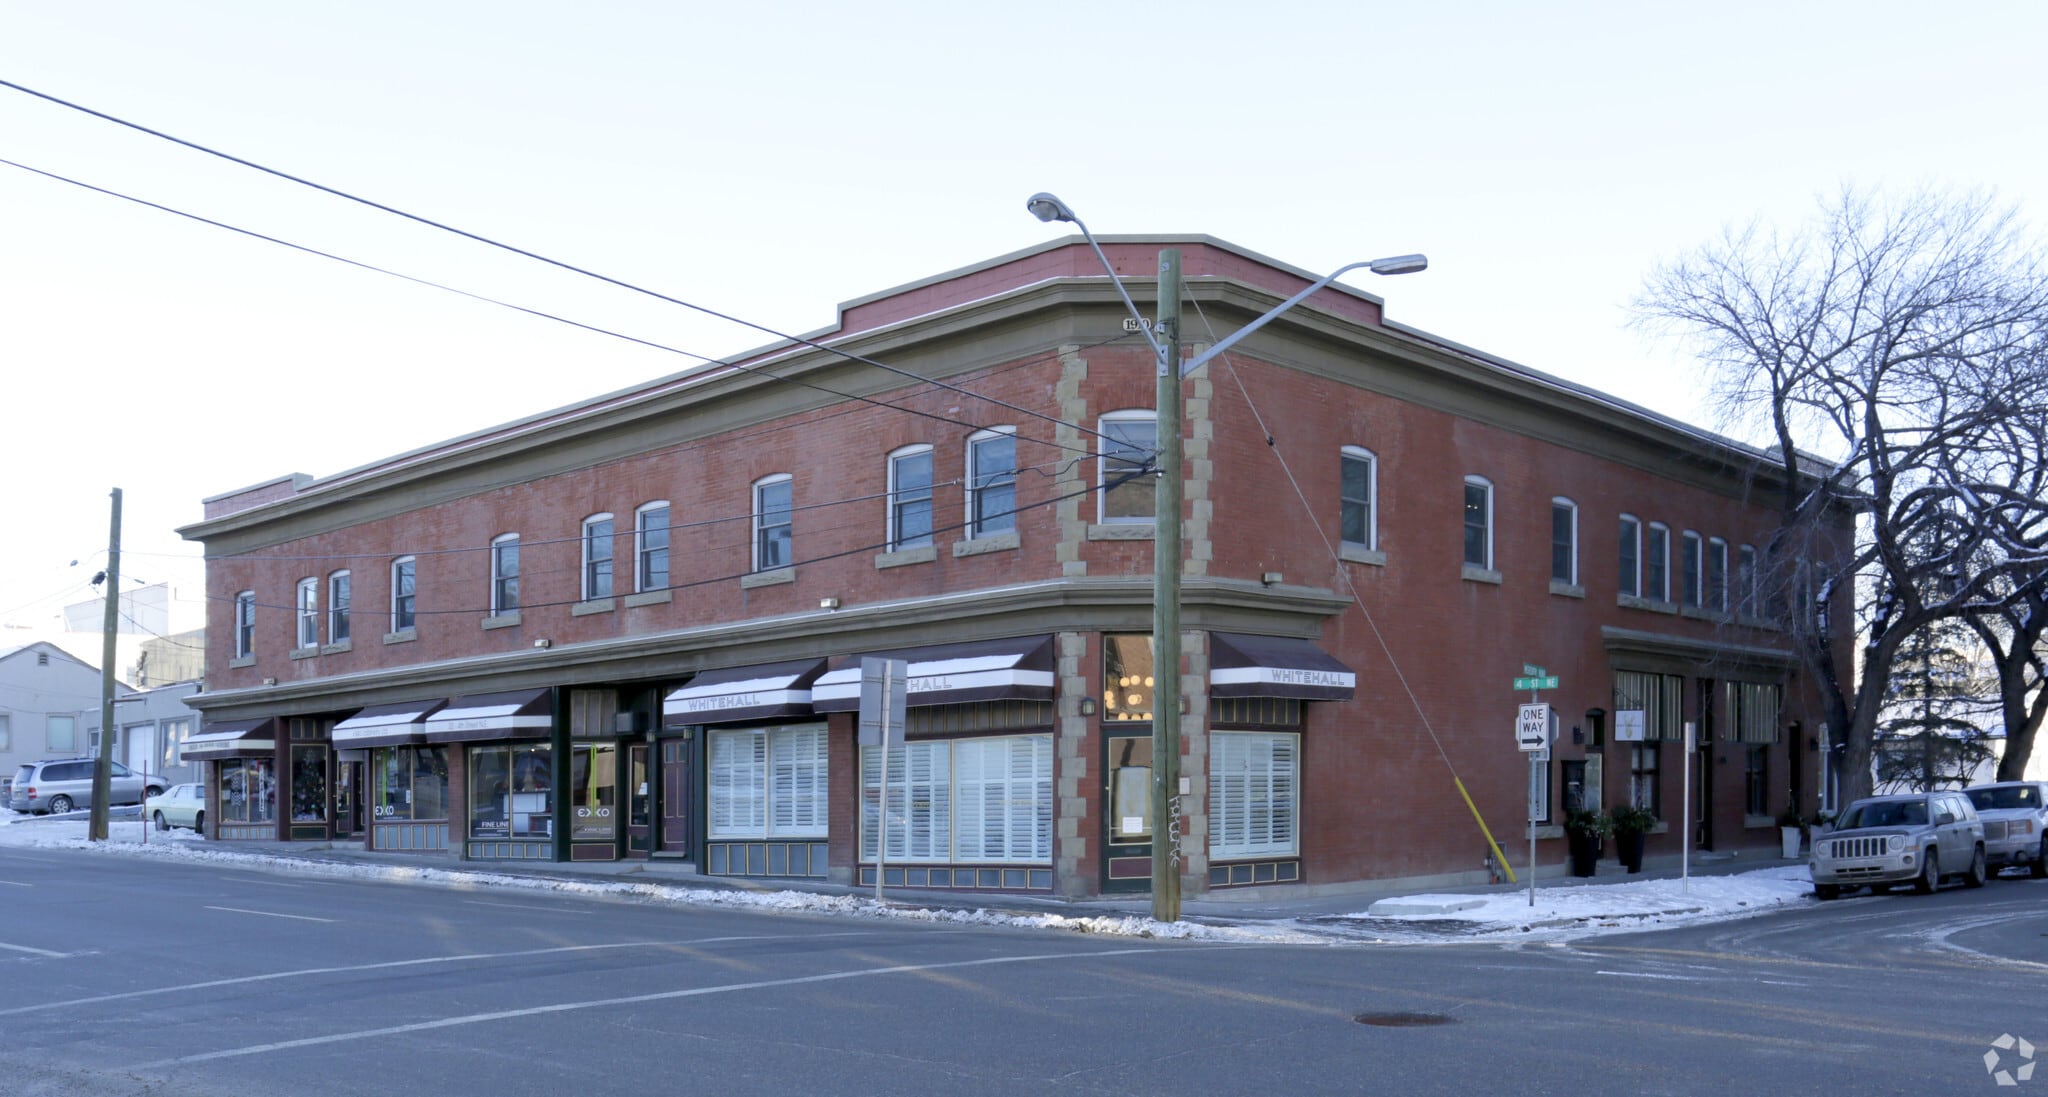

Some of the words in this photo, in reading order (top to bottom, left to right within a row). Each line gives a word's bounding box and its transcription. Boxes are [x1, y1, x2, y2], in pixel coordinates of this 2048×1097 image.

[1126, 319, 1149, 330] 190
[1271, 669, 1345, 686] WHITEHALL
[1516, 680, 1522, 689] 4
[1530, 679, 1539, 689] ST
[688, 694, 760, 711] WHITEHALL
[1523, 709, 1544, 721] ONE
[1522, 722, 1544, 734] WAY
